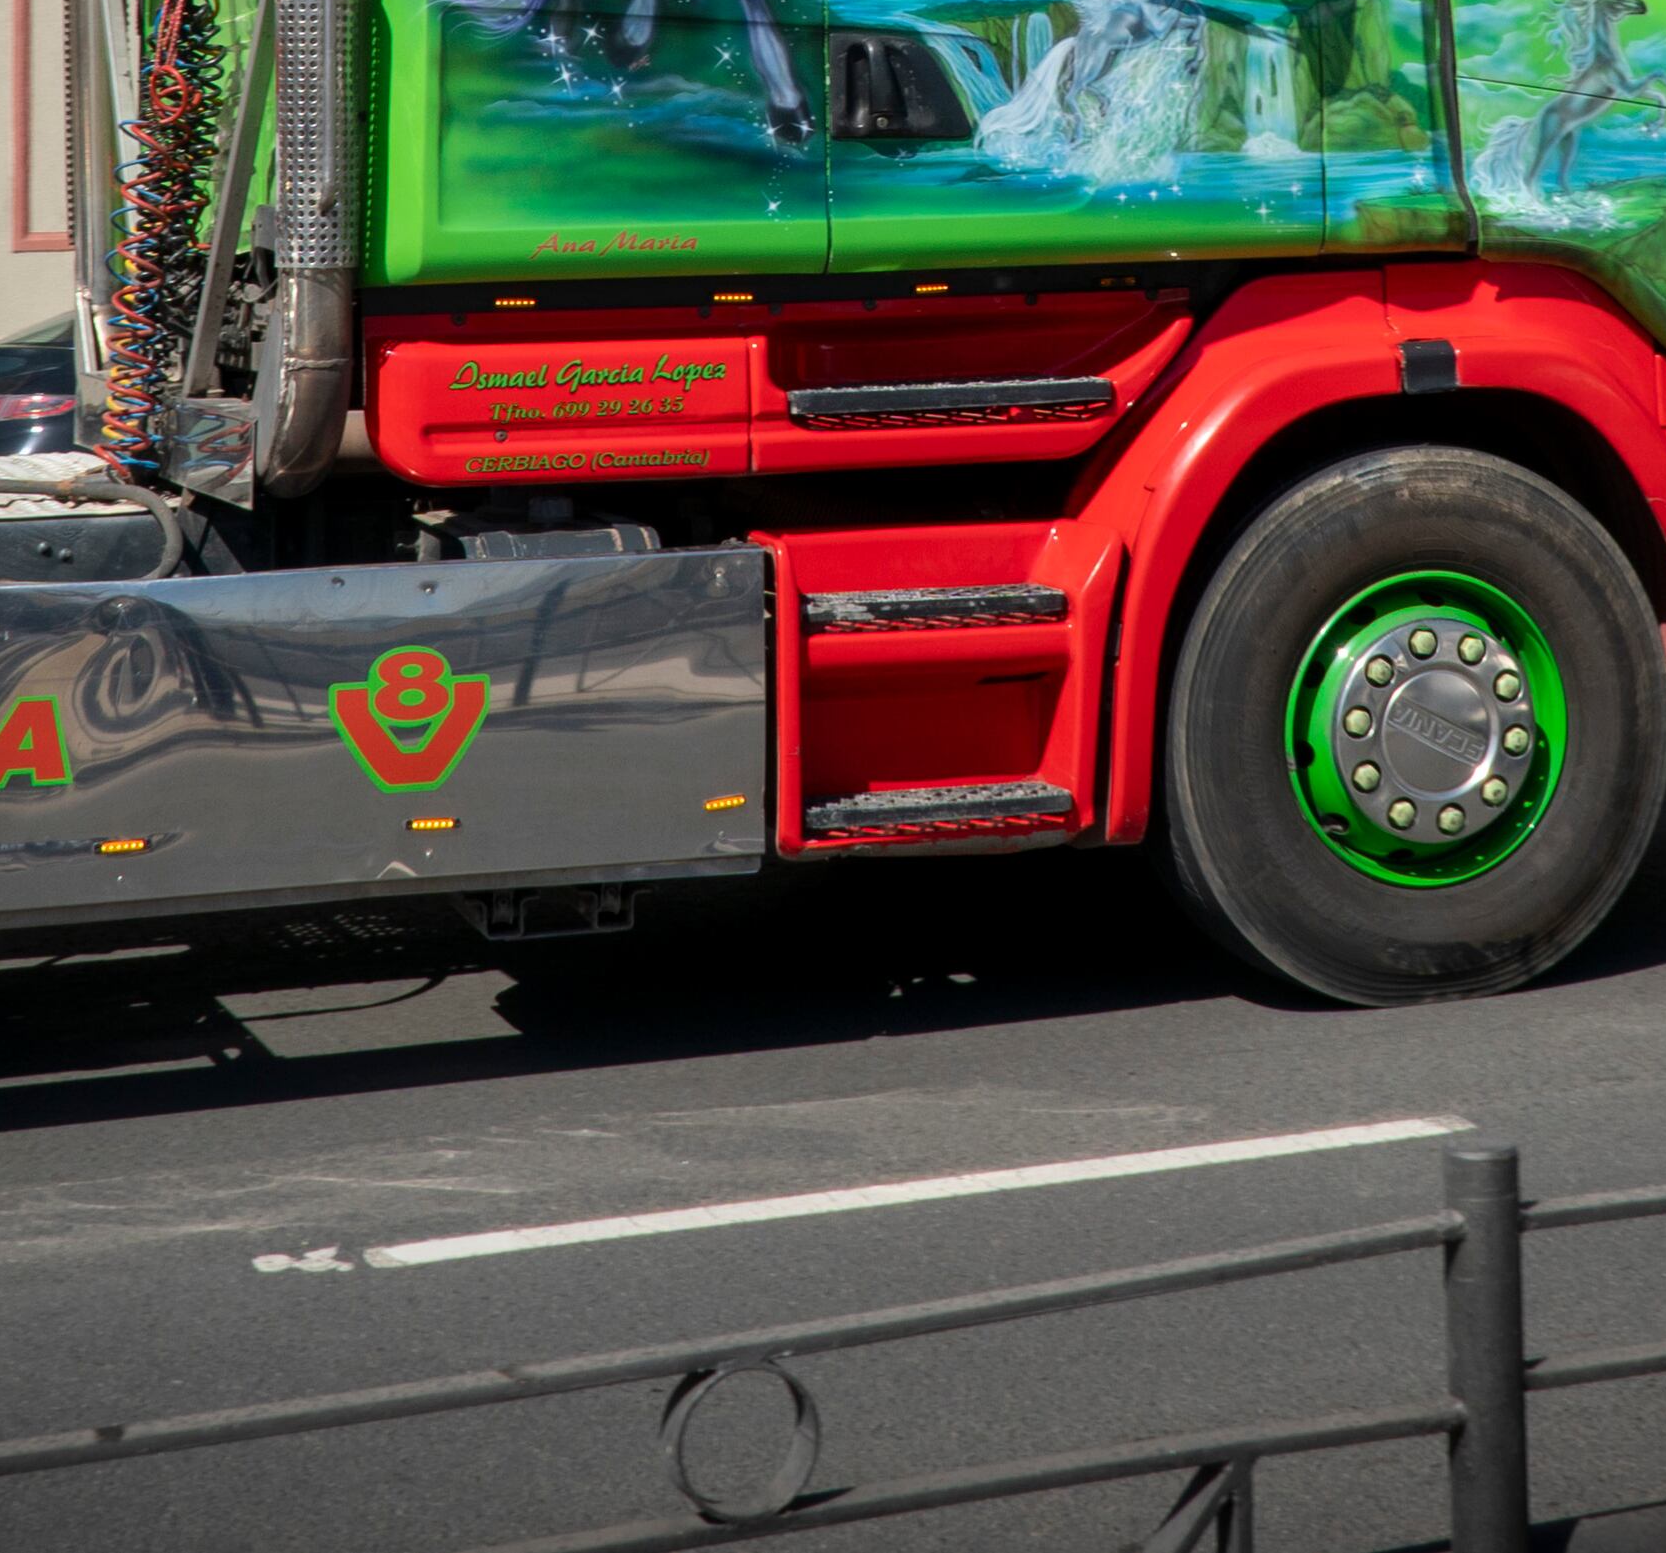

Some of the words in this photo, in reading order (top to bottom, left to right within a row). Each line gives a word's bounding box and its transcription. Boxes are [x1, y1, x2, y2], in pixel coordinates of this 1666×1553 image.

[529, 233, 595, 260] Ana
[598, 229, 699, 257] Maria
[449, 360, 549, 390] Ismael
[555, 358, 644, 393] Garcia
[650, 353, 726, 392] Lopez
[489, 403, 546, 424] Tfno.
[552, 401, 591, 418] 699
[595, 399, 623, 417] 29
[627, 398, 654, 415] 26
[659, 396, 685, 413] 35
[465, 452, 587, 473] CERBIAGO
[590, 450, 710, 471] (Cantabria)
